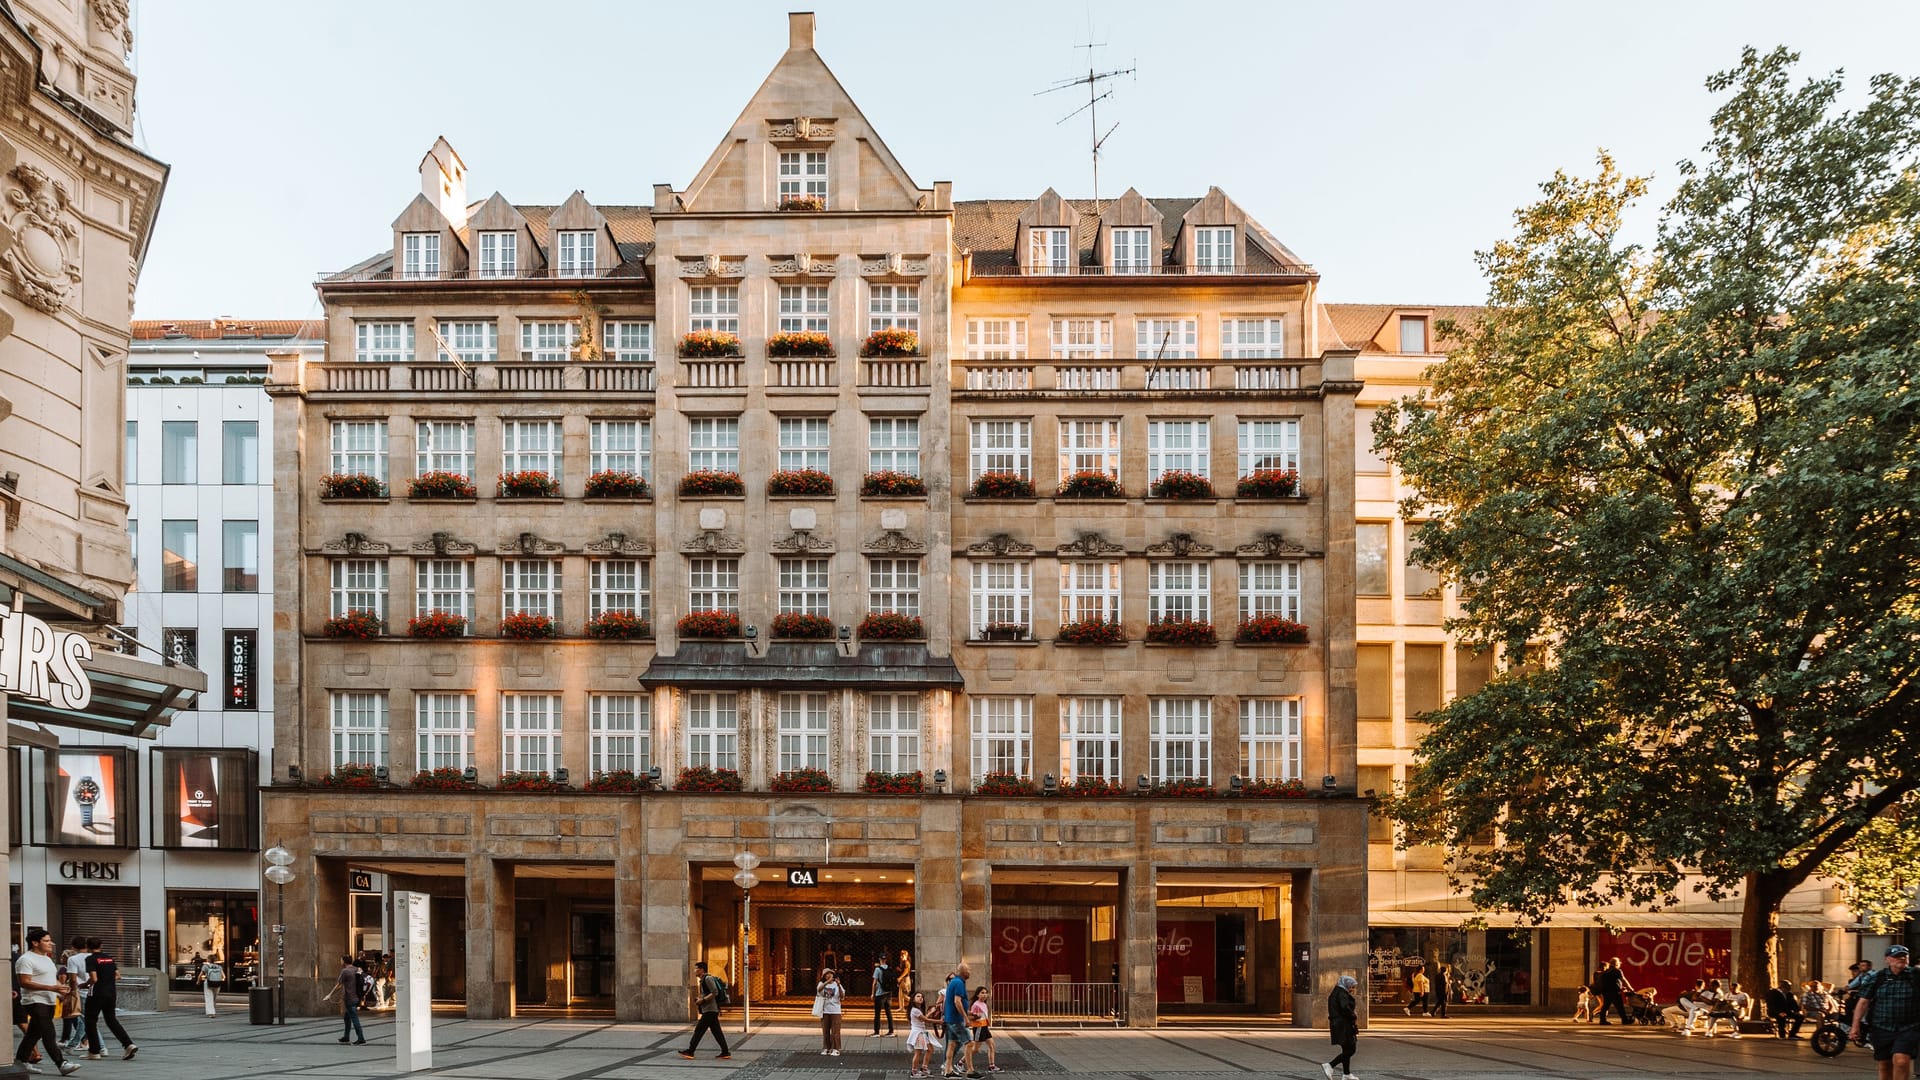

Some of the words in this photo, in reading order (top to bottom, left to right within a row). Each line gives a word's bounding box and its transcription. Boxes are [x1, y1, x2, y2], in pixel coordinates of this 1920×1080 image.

[233, 636, 244, 686] TISSOT
[60, 860, 122, 881] CHRIST
[790, 871, 815, 885] C&A
[823, 911, 847, 926] C&A
[999, 926, 1064, 955] Sale
[1626, 932, 1705, 967] Sale
